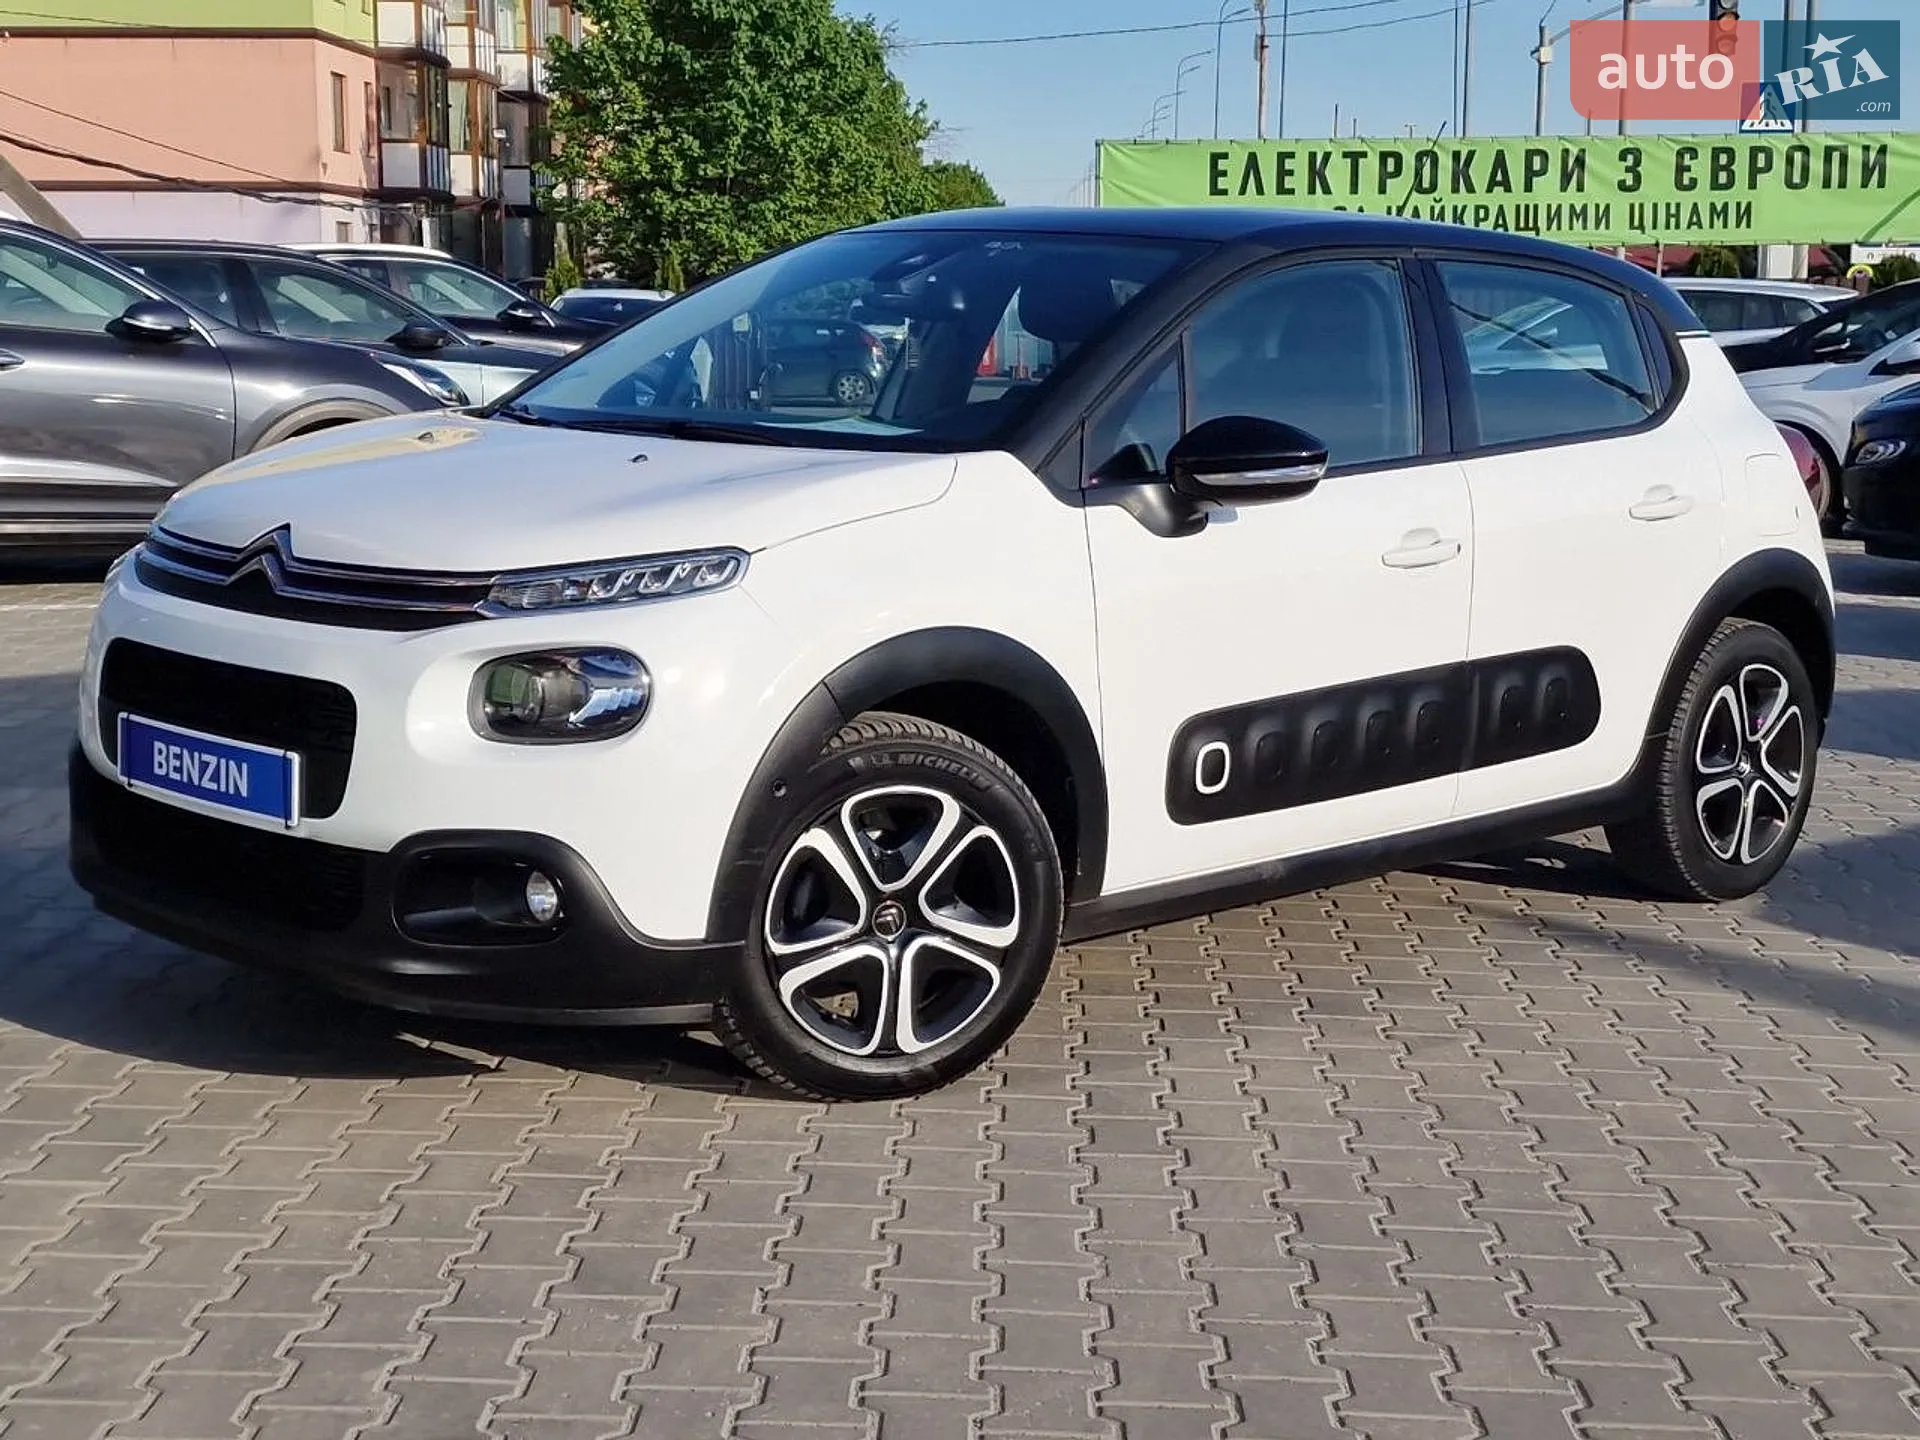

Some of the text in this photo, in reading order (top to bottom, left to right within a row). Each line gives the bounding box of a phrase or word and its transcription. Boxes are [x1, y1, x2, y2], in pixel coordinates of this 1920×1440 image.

[1207, 147, 1587, 197] ЕЛЕКТРОКАРИ
[1673, 143, 1889, 192] ЄВРОПИ
[1627, 200, 1753, 235] ЦІНАМИ
[153, 740, 249, 798] BENZIN
